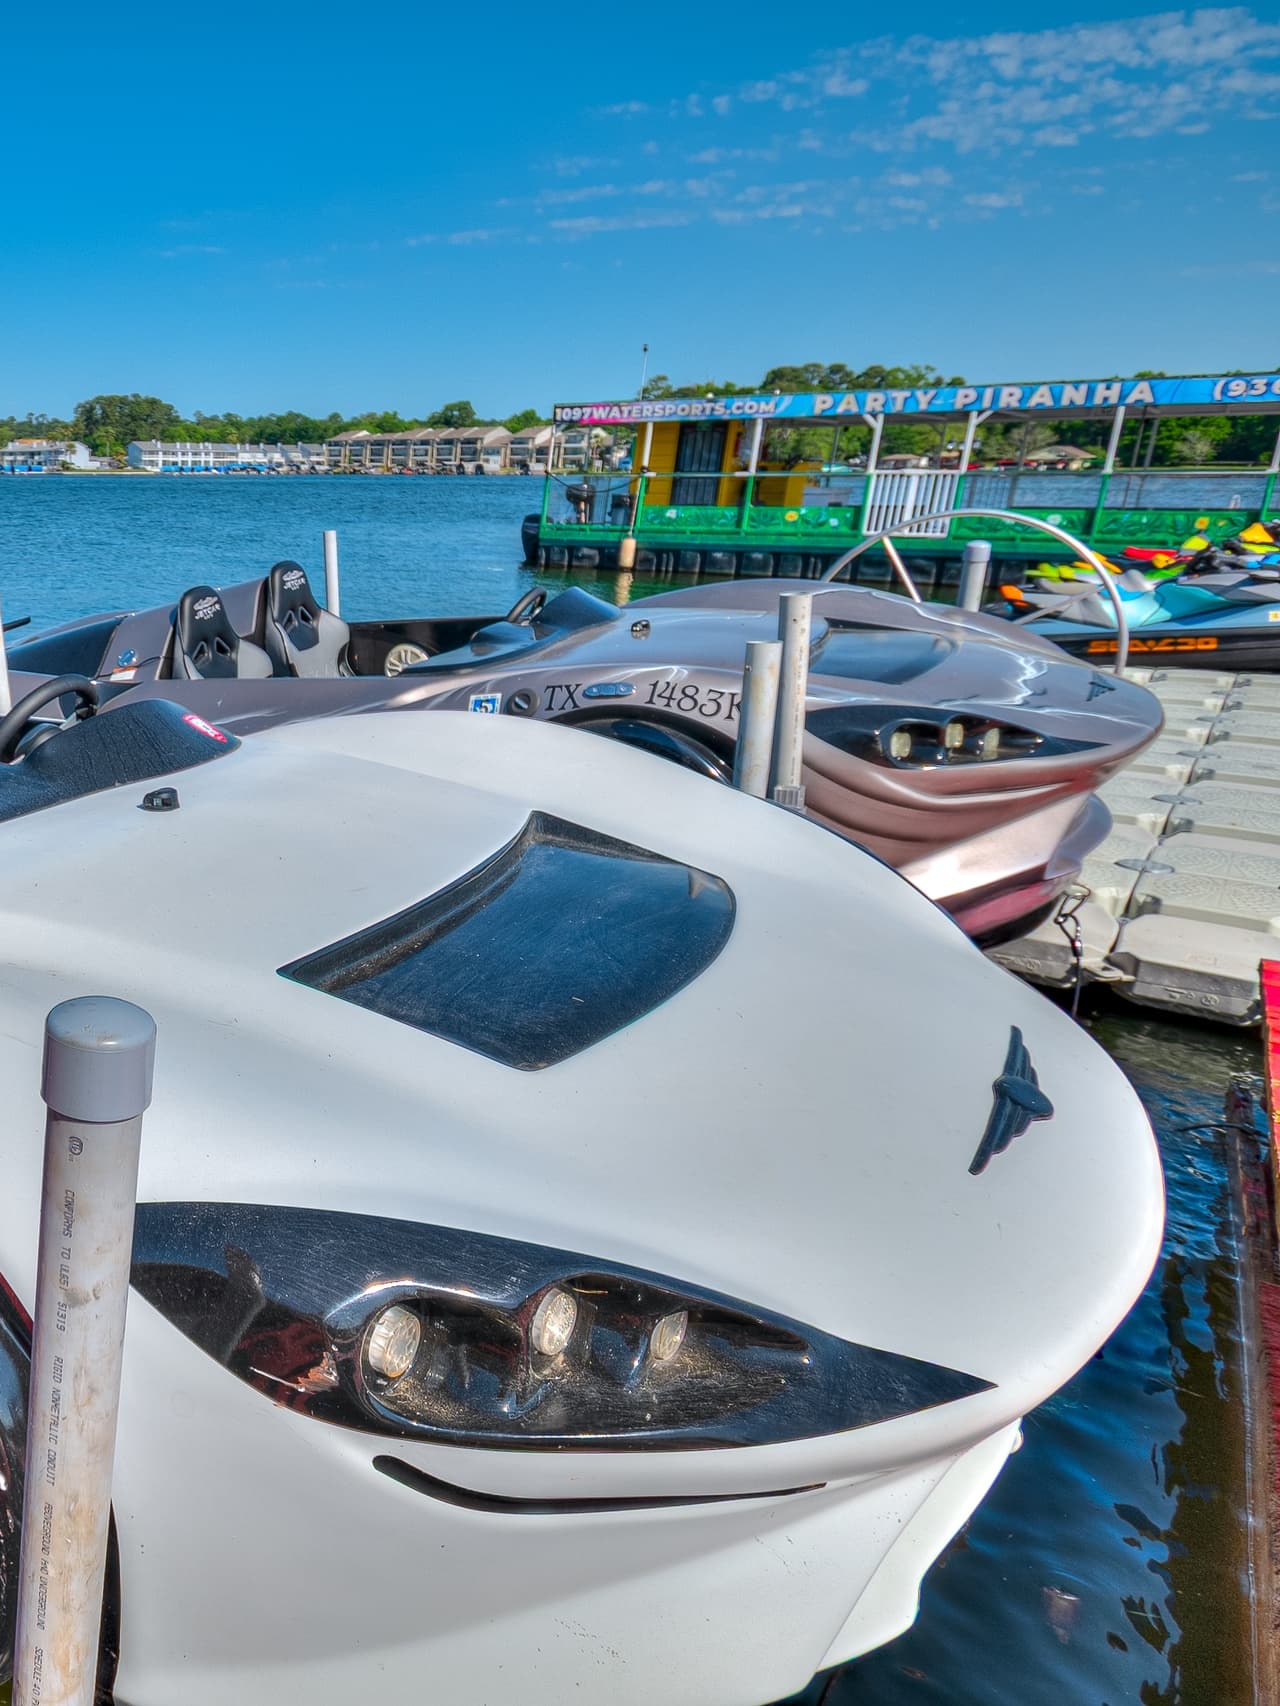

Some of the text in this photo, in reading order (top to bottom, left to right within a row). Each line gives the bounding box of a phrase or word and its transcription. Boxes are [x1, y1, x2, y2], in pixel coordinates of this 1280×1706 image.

[555, 400, 776, 420] 1097WATERSPORTS.COM
[813, 390, 937, 415] PARTY
[954, 380, 1155, 409] PIRANHA
[544, 684, 583, 711] TX
[62, 1189, 75, 1239] CONFORMS
[61, 1246, 72, 1261] TO
[52, 1355, 64, 1384] RIGID
[49, 1387, 61, 1445] NONMETALLIC
[46, 1448, 57, 1486] CONDUIT
